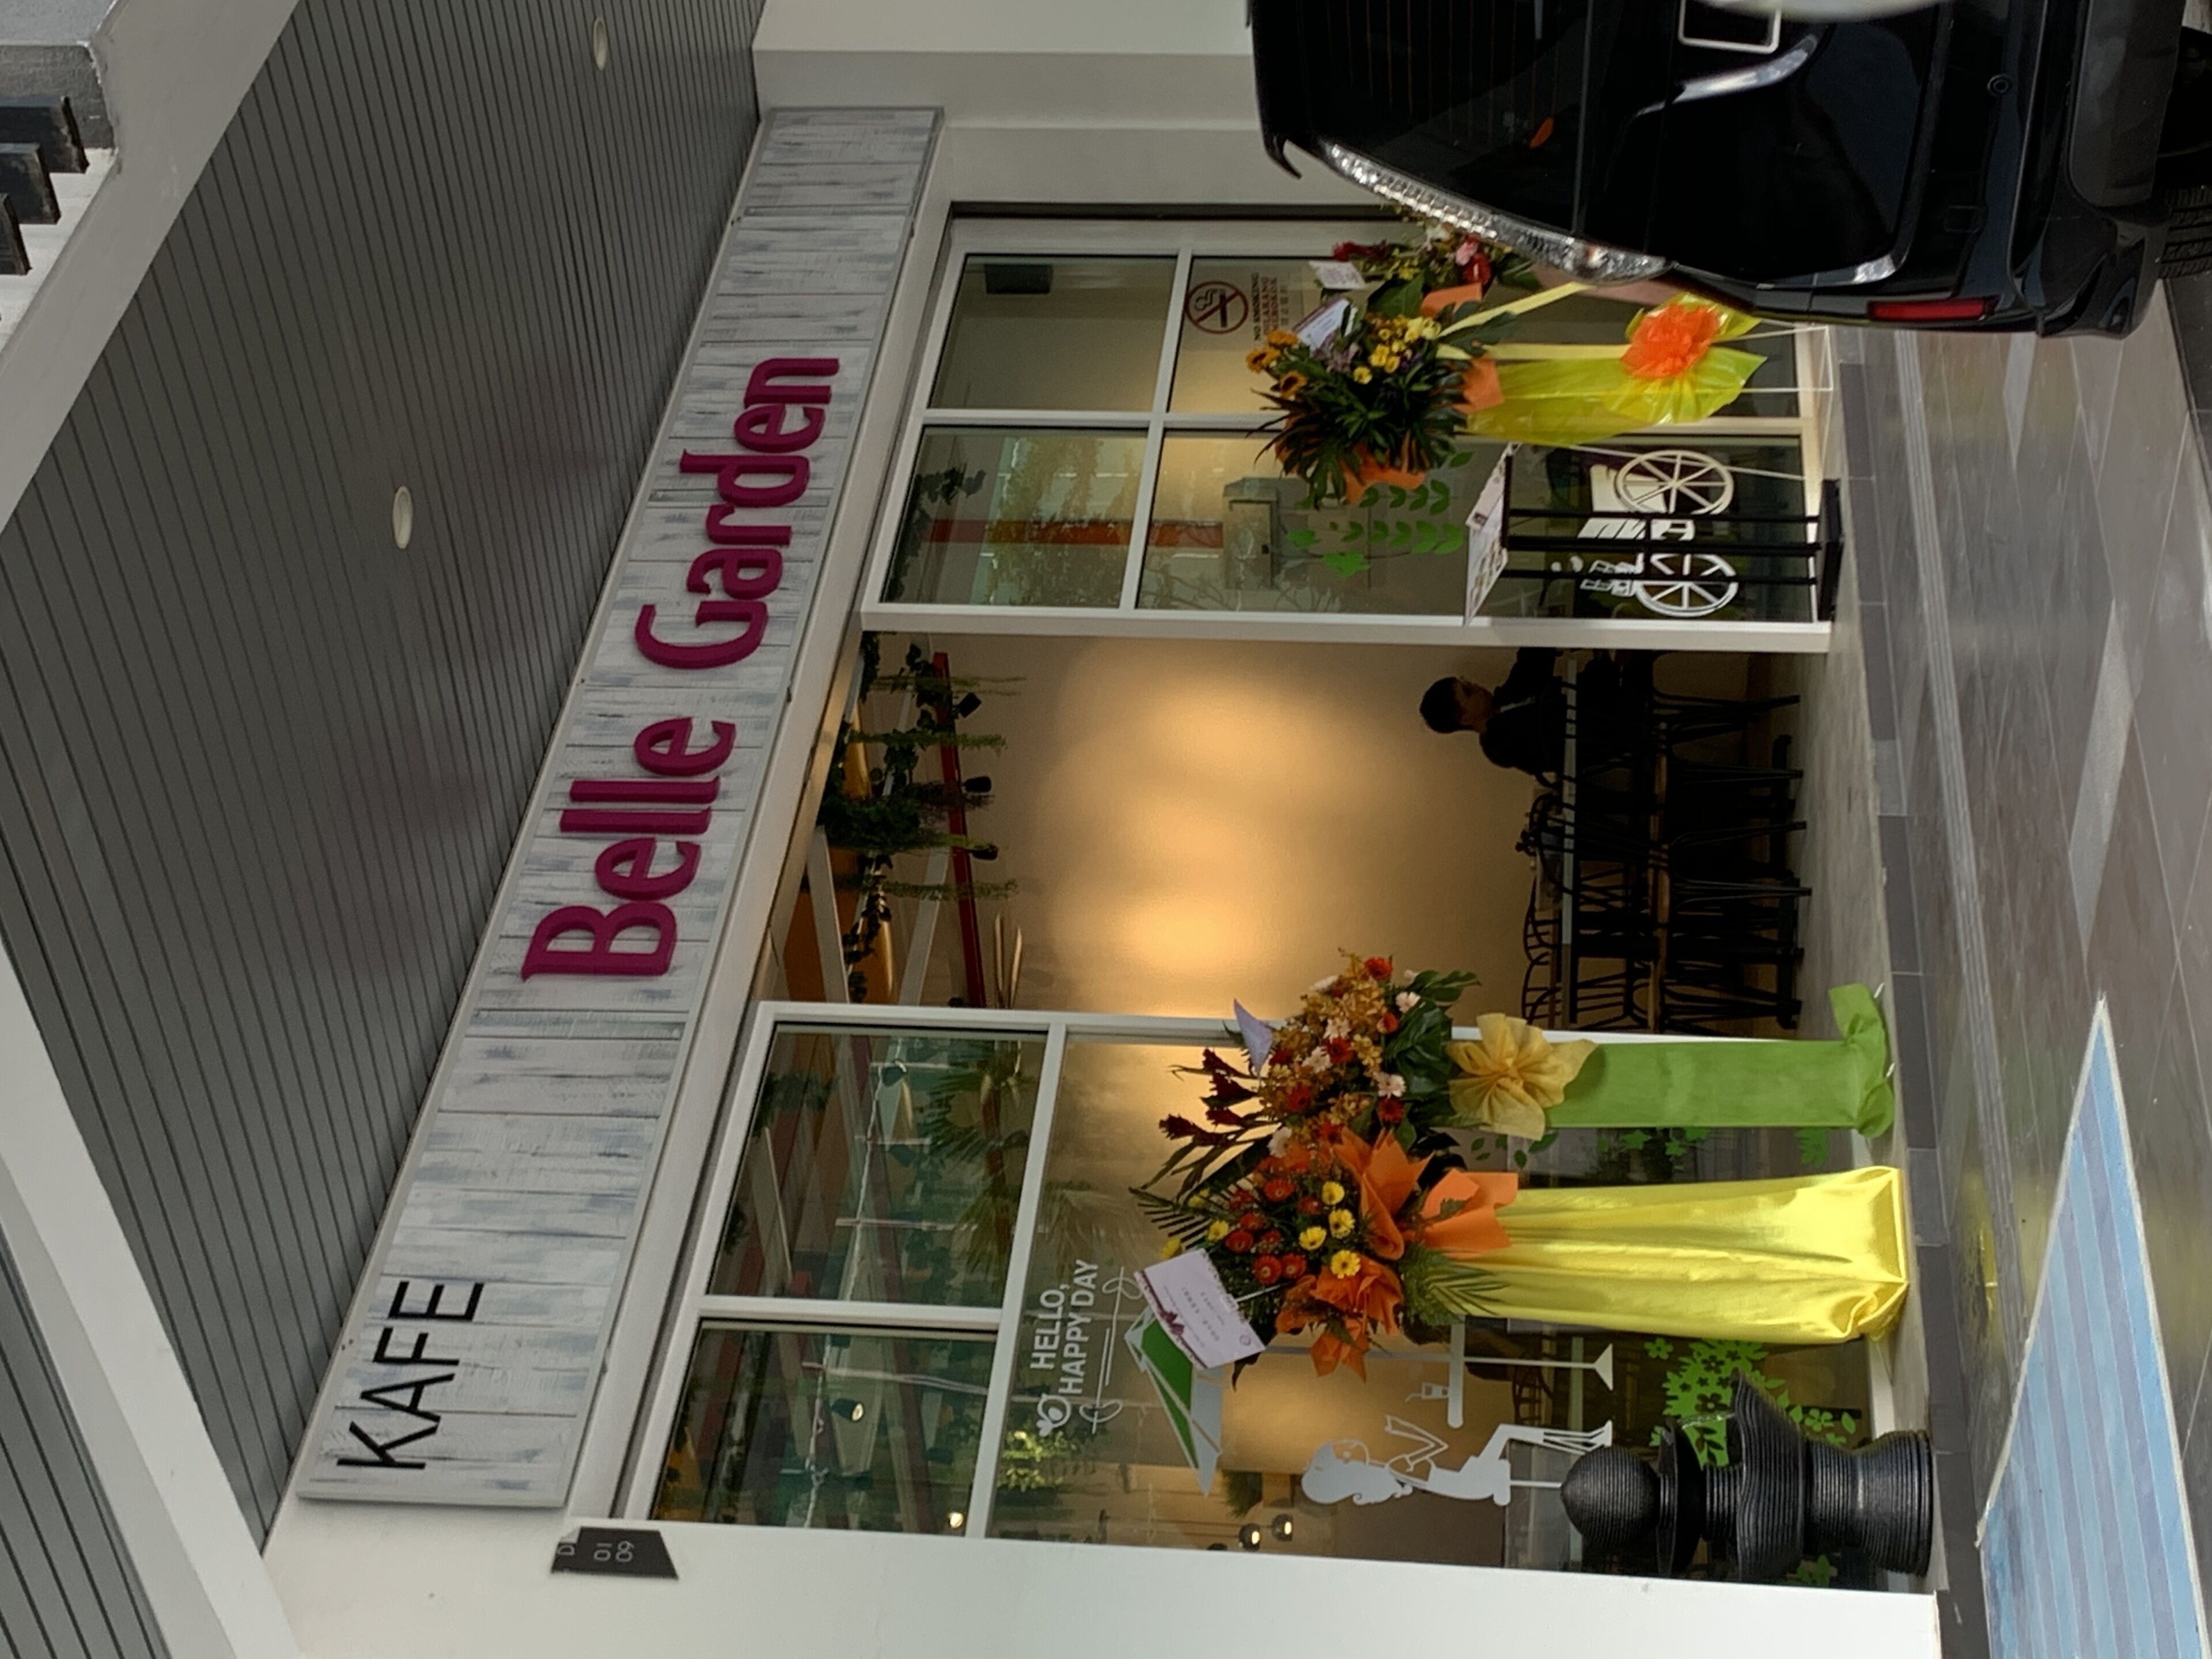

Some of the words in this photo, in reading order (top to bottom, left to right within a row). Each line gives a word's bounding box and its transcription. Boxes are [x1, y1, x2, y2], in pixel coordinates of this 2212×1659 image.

[1251, 272, 1260, 323] SMOKING
[1253, 325, 1261, 340] NO
[520, 717, 736, 982] Belle
[634, 357, 840, 669] Garden
[1070, 1259, 1099, 1306] DAY
[1030, 1283, 1070, 1370] HELLO,
[337, 1281, 484, 1471] KAFE
[1058, 1312, 1092, 1395] HAPPY
[593, 1542, 612, 1561] 01
[616, 1540, 635, 1563] 09
